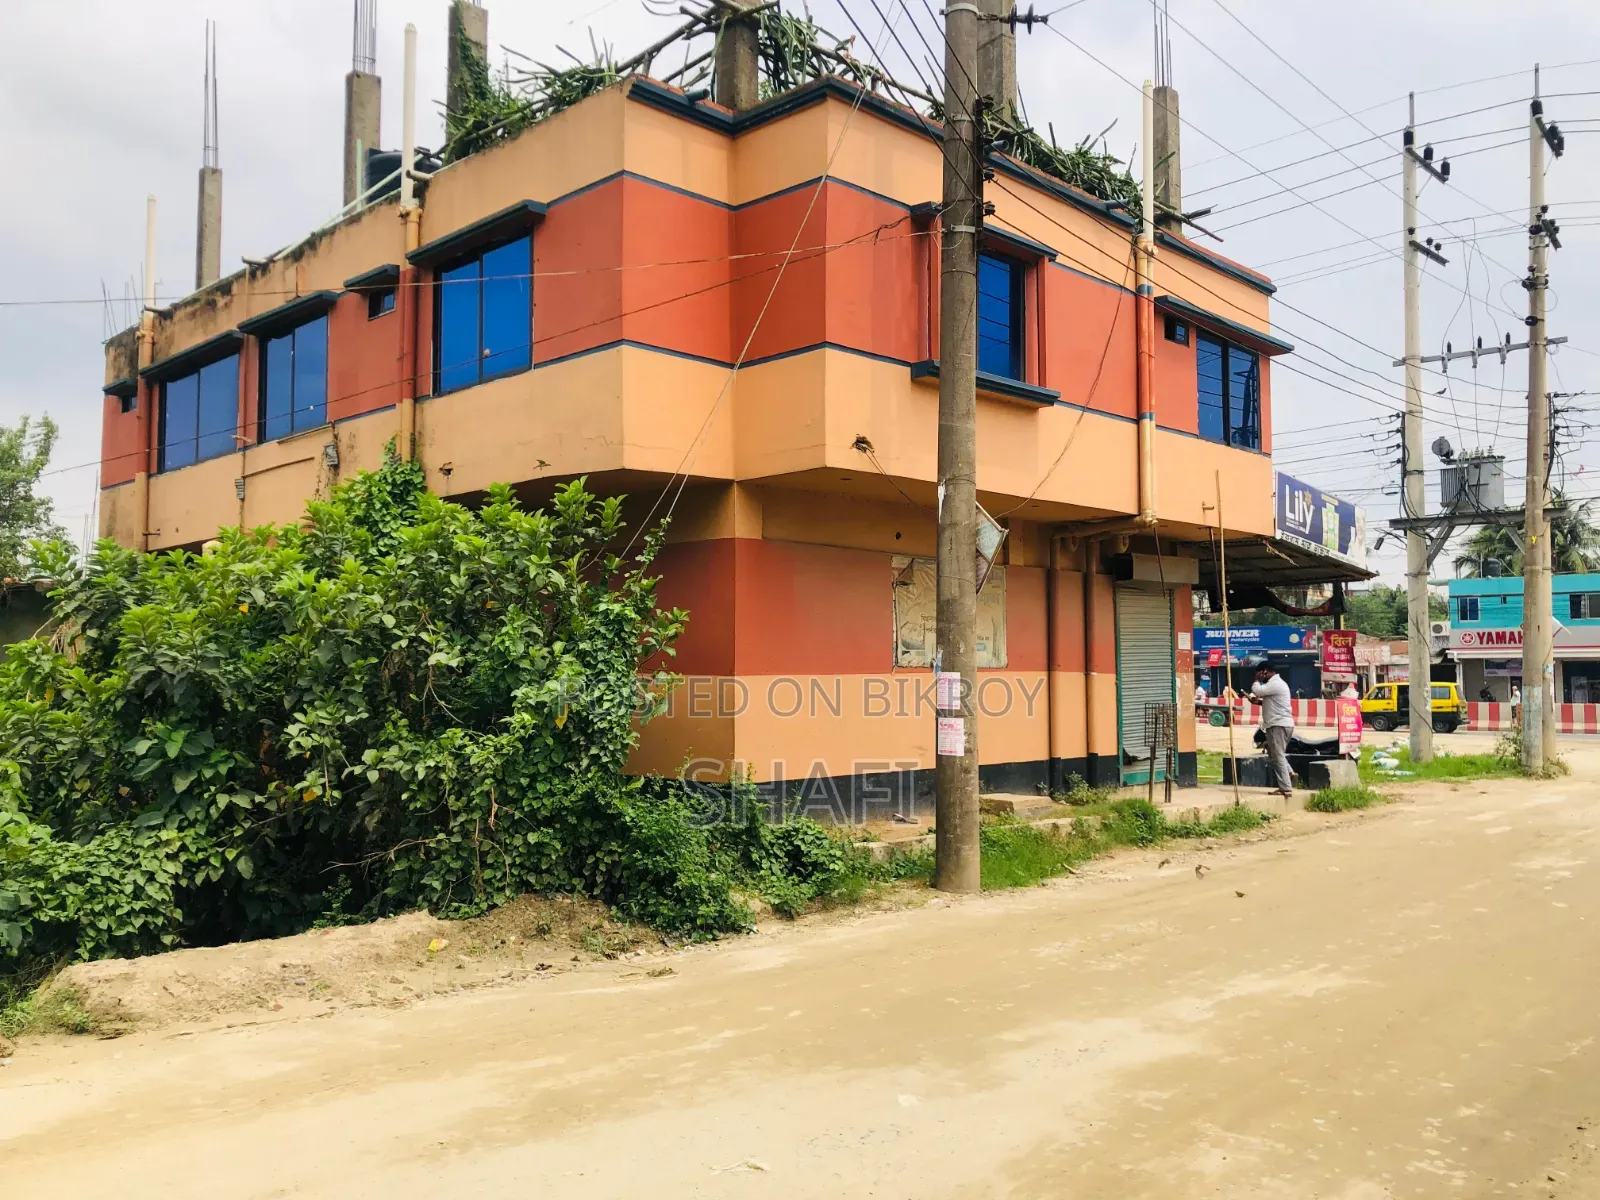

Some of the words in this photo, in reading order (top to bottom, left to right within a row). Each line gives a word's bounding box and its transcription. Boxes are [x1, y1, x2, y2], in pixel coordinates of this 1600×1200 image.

[1285, 484, 1315, 534] Lily
[1205, 629, 1260, 638] RUNNER
[1476, 631, 1524, 645] YAMAH
